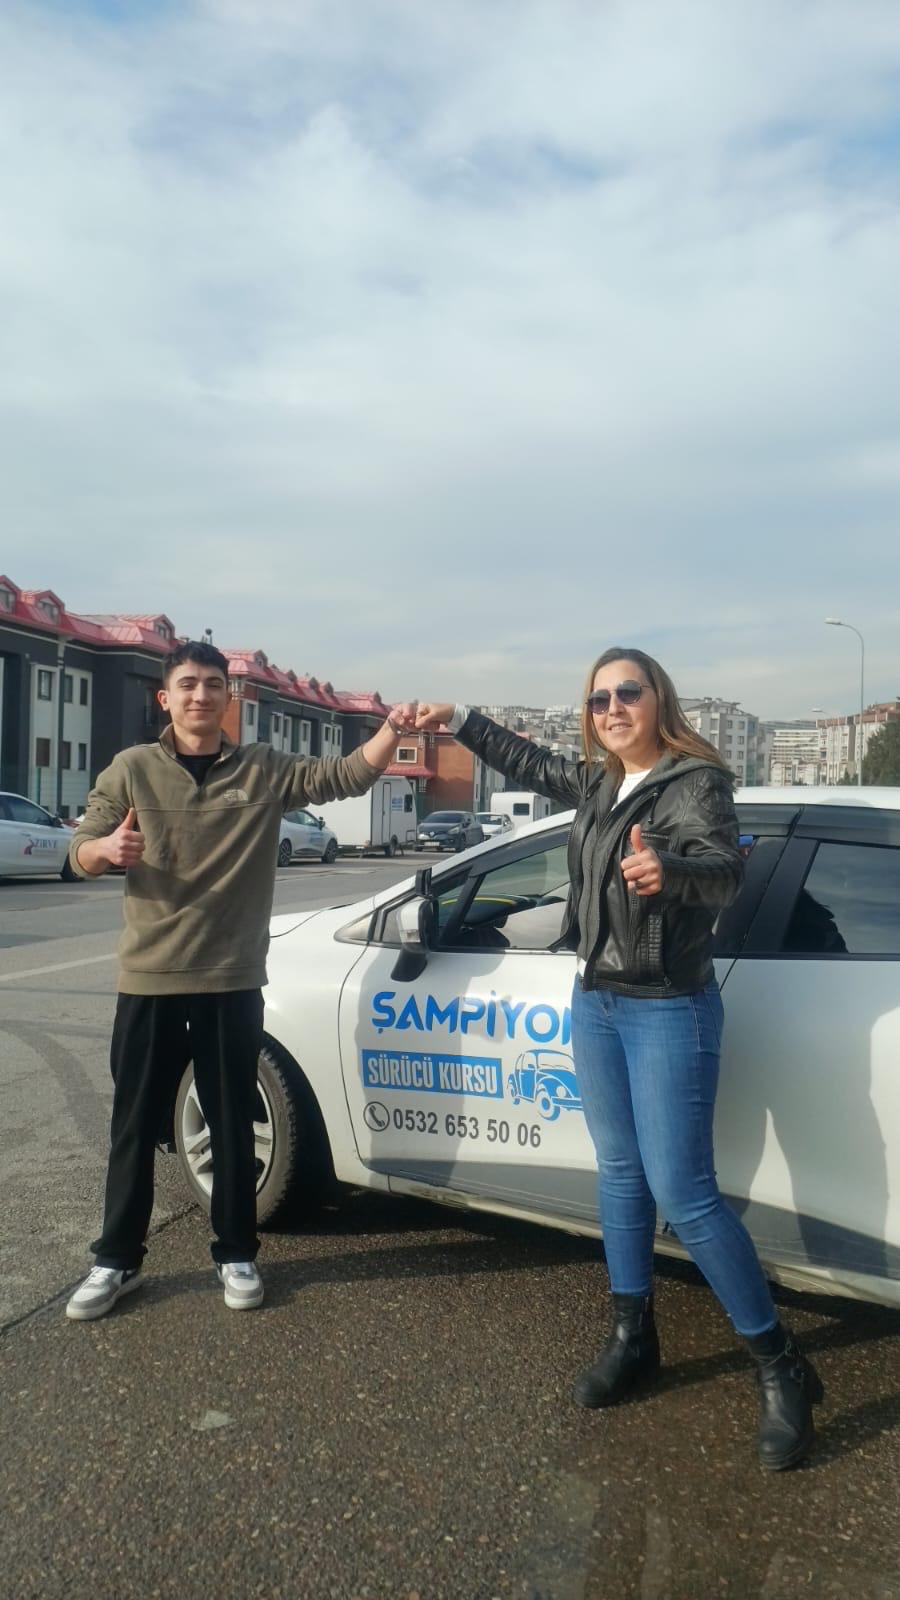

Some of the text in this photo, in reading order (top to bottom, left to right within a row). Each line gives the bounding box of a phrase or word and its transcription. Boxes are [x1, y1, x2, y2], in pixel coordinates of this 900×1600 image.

[368, 1054, 498, 1094] SÜRÜCÜ KURSU
[393, 1108, 541, 1148] 0532 653 50 06
